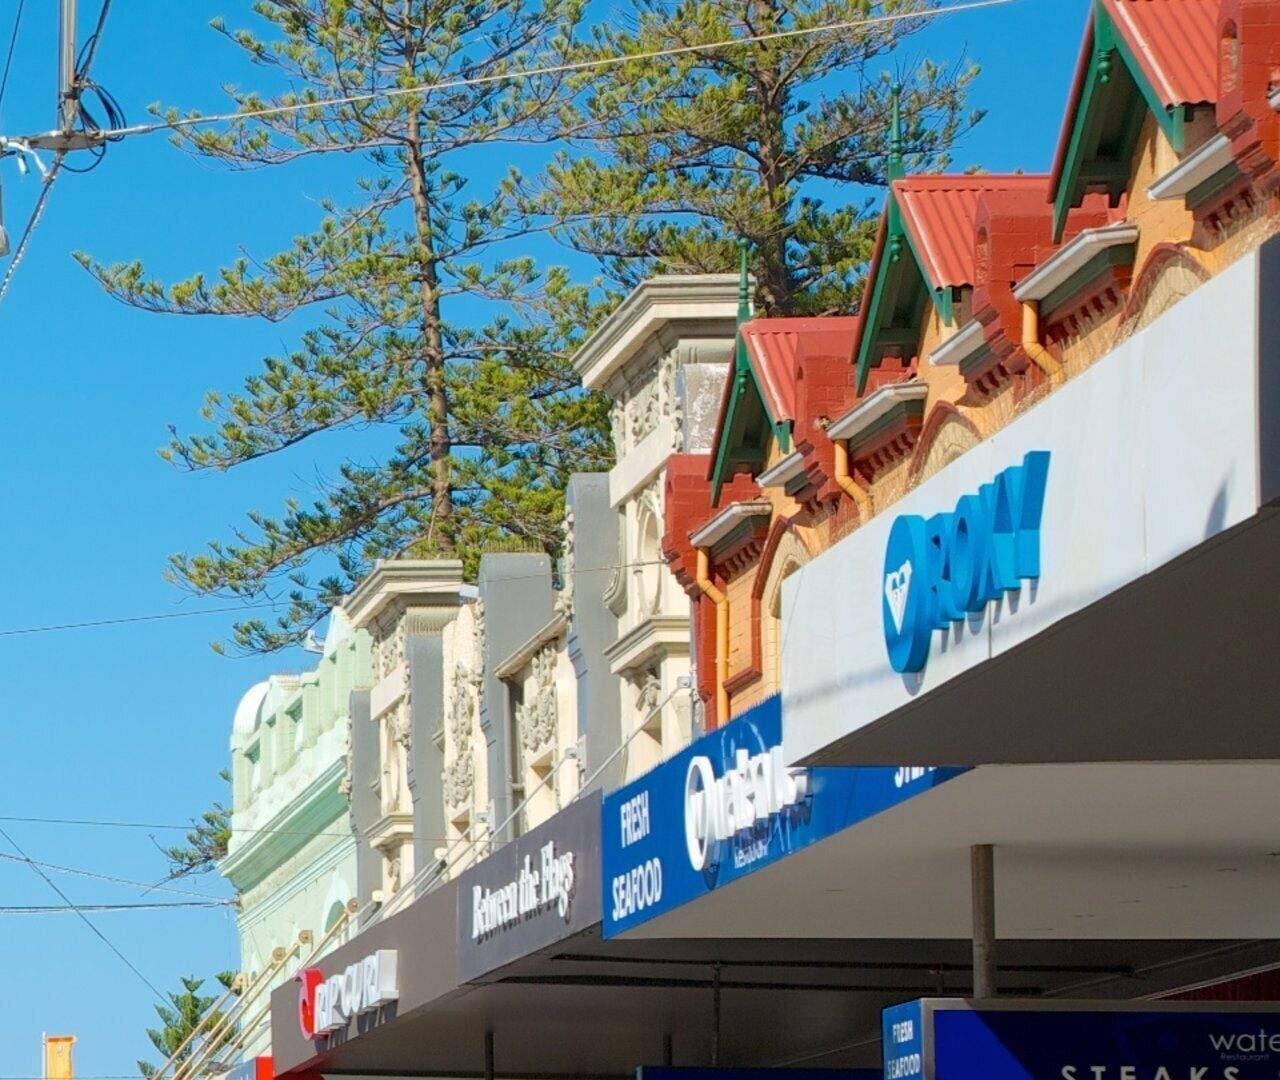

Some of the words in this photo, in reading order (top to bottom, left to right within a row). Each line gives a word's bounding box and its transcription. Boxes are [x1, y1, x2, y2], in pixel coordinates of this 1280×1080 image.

[925, 451, 1051, 630] ROXY
[621, 790, 650, 848] FRESH
[519, 854, 539, 914] the
[540, 840, 573, 917] Flags
[612, 857, 662, 921] SEAFOOD
[342, 949, 399, 1017] CURL
[893, 1020, 914, 1043] FRESH
[888, 1053, 921, 1079] SEAFOOD
